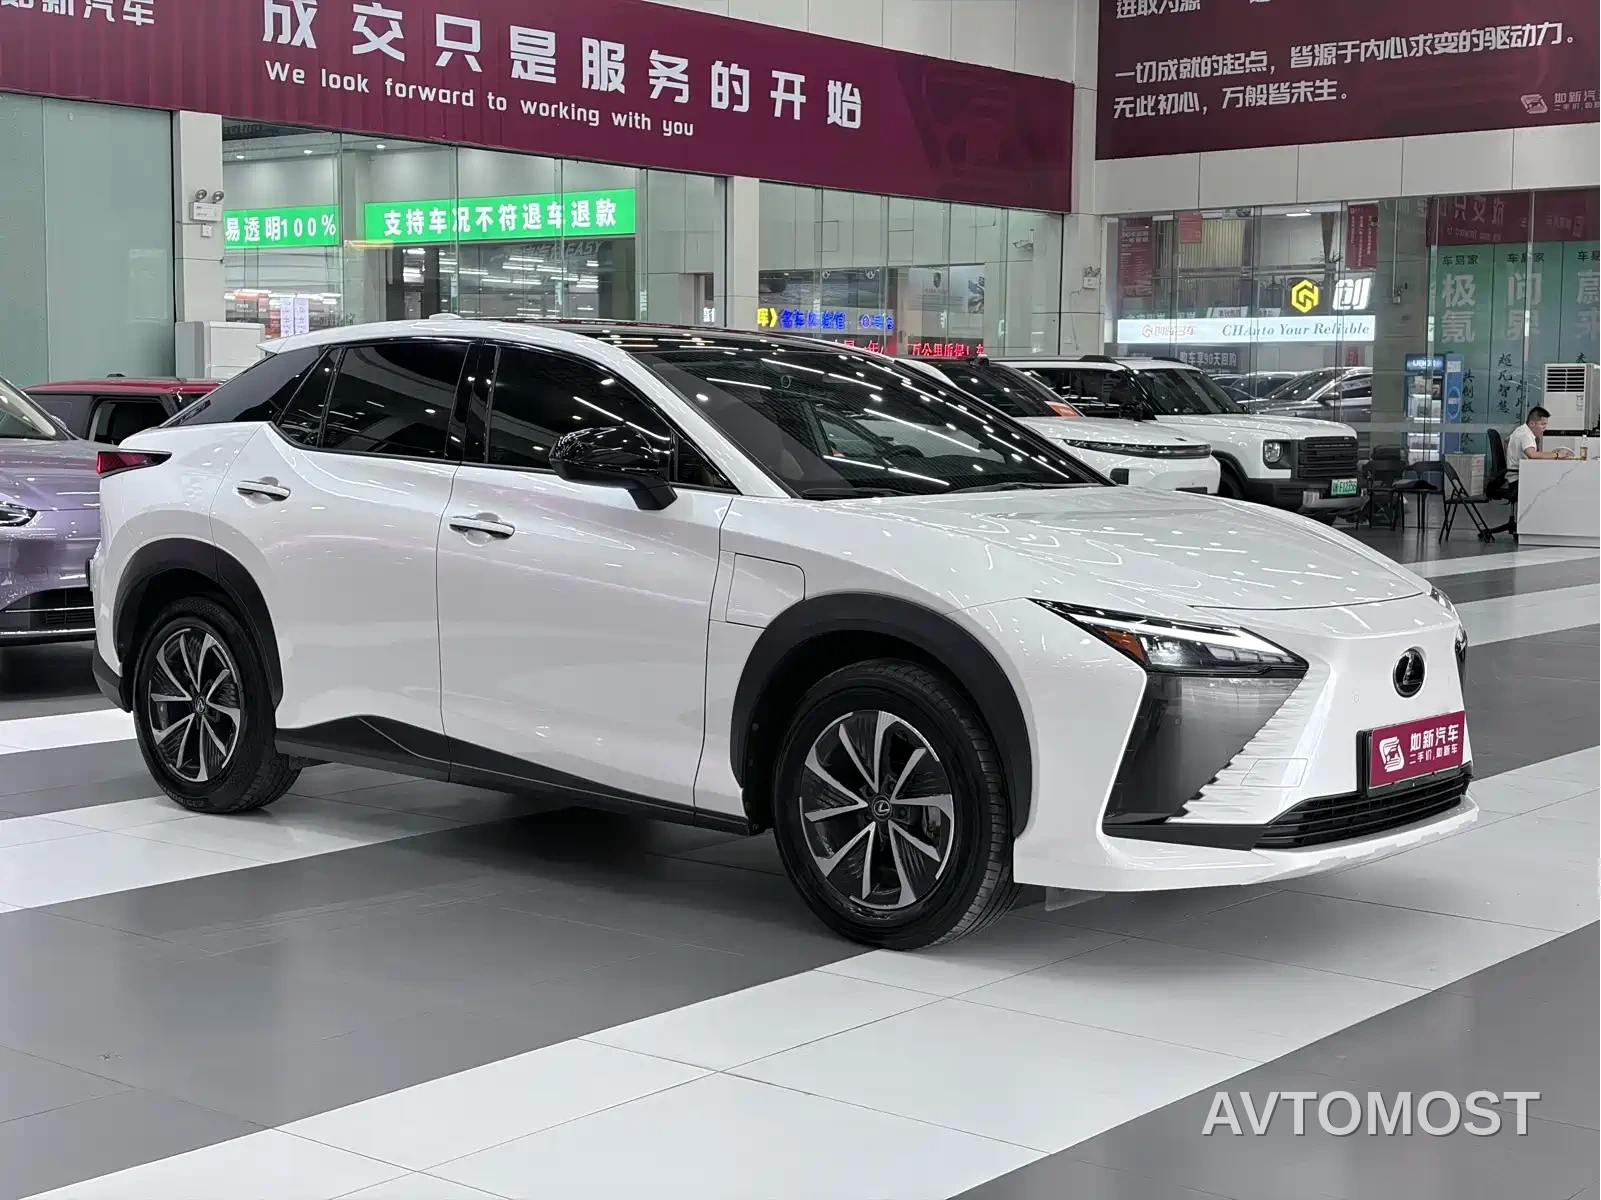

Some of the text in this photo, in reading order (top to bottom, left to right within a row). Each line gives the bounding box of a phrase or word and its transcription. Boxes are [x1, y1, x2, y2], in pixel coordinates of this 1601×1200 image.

[262, 0, 864, 130] 成交只是服务的开始
[266, 60, 695, 138] We look forward to working with you
[1112, 79, 1348, 119] 无此初心，万般皆未生。
[383, 197, 617, 237] 支持车况不符退车退款
[1442, 254, 1479, 267] 车易家
[1279, 323, 1310, 337] Your
[1313, 322, 1370, 335] Reliable
[1409, 724, 1459, 752] 如新汽车
